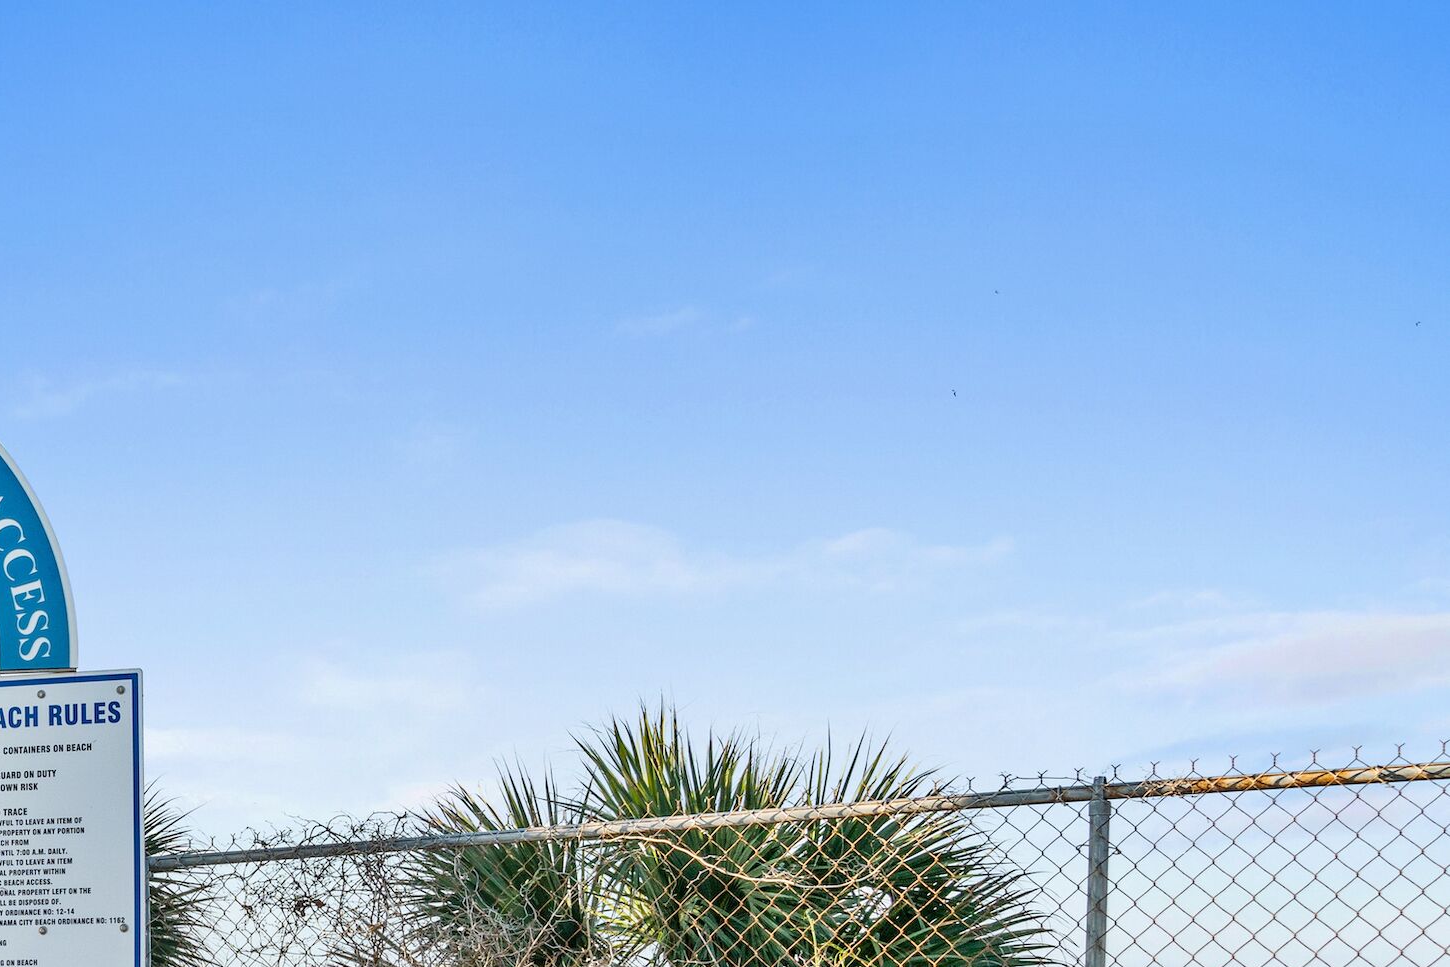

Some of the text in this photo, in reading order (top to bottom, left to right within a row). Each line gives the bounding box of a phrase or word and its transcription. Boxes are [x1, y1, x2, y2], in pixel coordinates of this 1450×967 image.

[48, 701, 123, 726] RULES
[3, 745, 51, 755] CONTAINERS
[66, 744, 93, 752] BEACH
[37, 770, 58, 778] DUTY
[20, 783, 40, 791] RISK
[3, 808, 29, 816] TRACE
